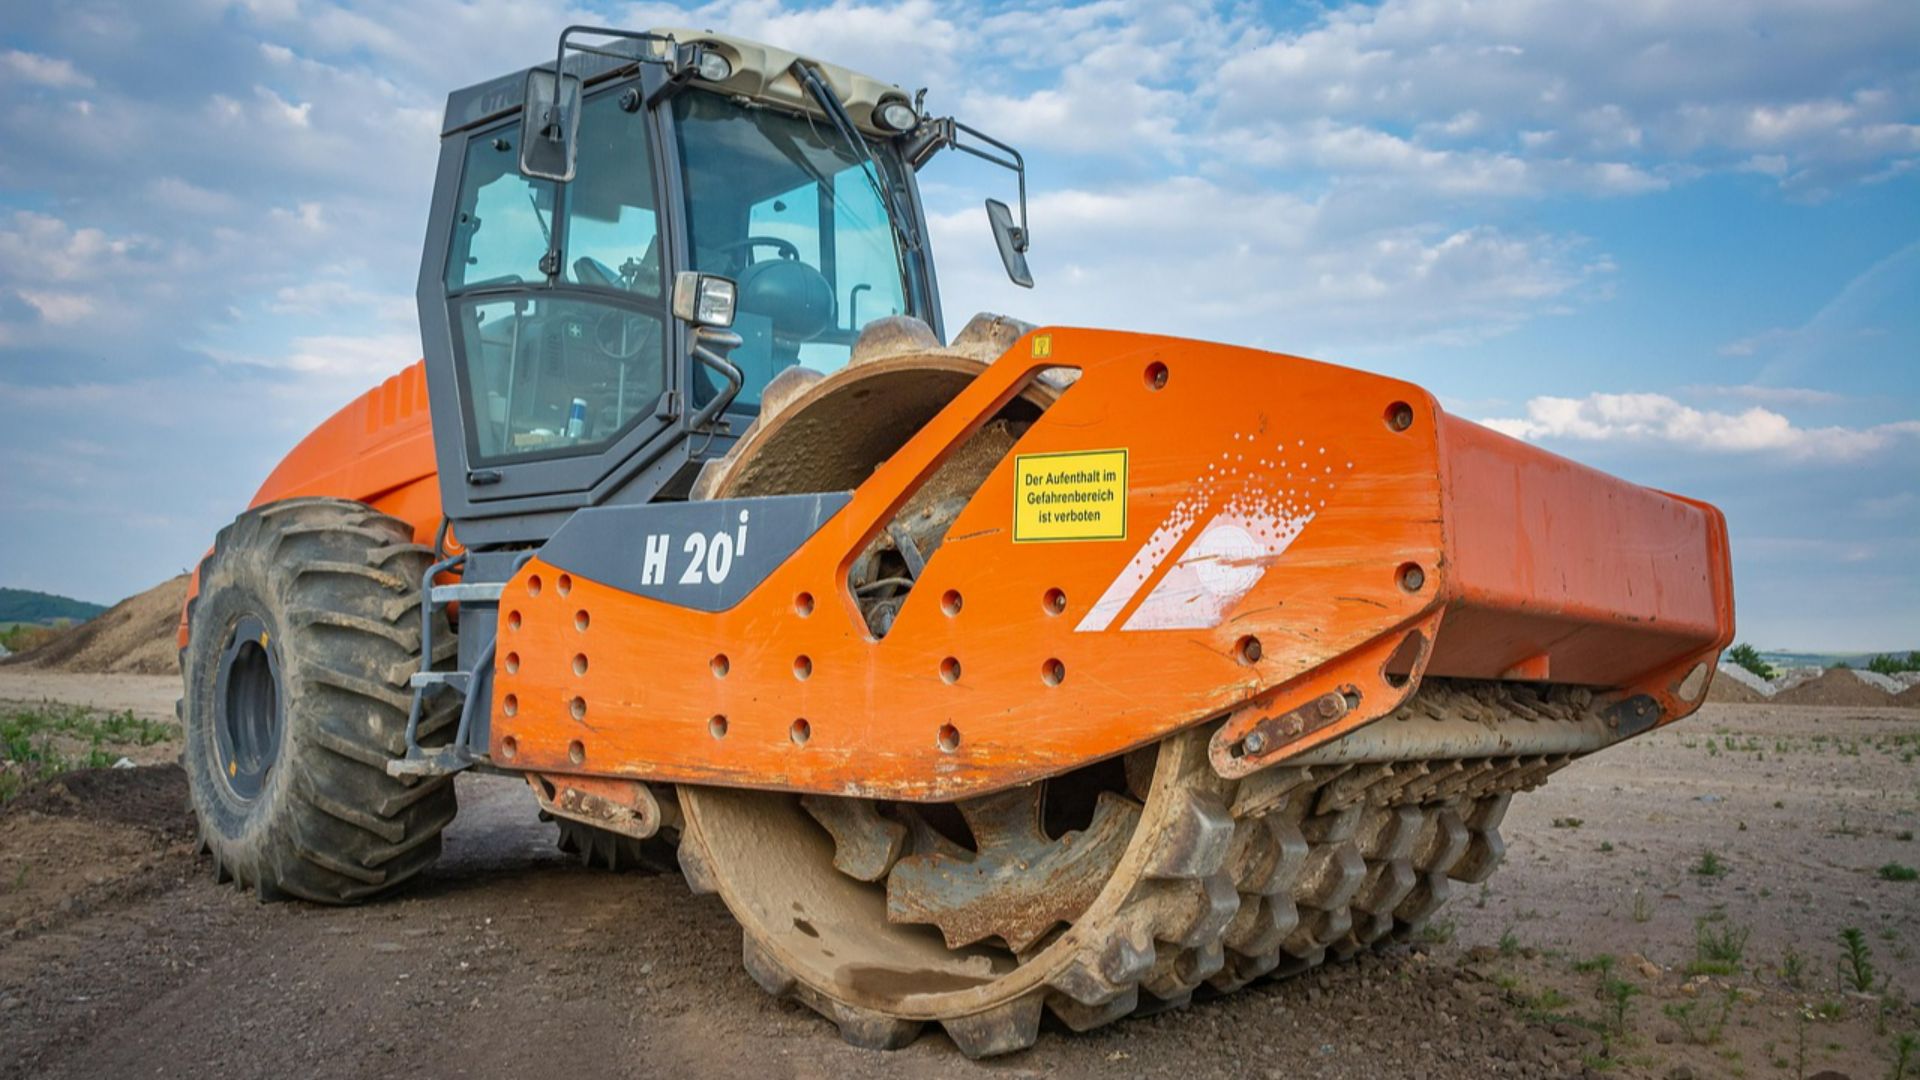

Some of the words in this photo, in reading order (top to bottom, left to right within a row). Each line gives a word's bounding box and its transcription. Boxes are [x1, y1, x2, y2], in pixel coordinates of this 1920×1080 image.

[1025, 473, 1042, 486] Der
[1045, 470, 1100, 485] Aufenthalt
[1103, 469, 1116, 482] im
[1027, 489, 1114, 505] Gefahrenbereich
[1039, 510, 1051, 523] ist
[1054, 509, 1101, 523] verboten
[641, 534, 670, 585] H
